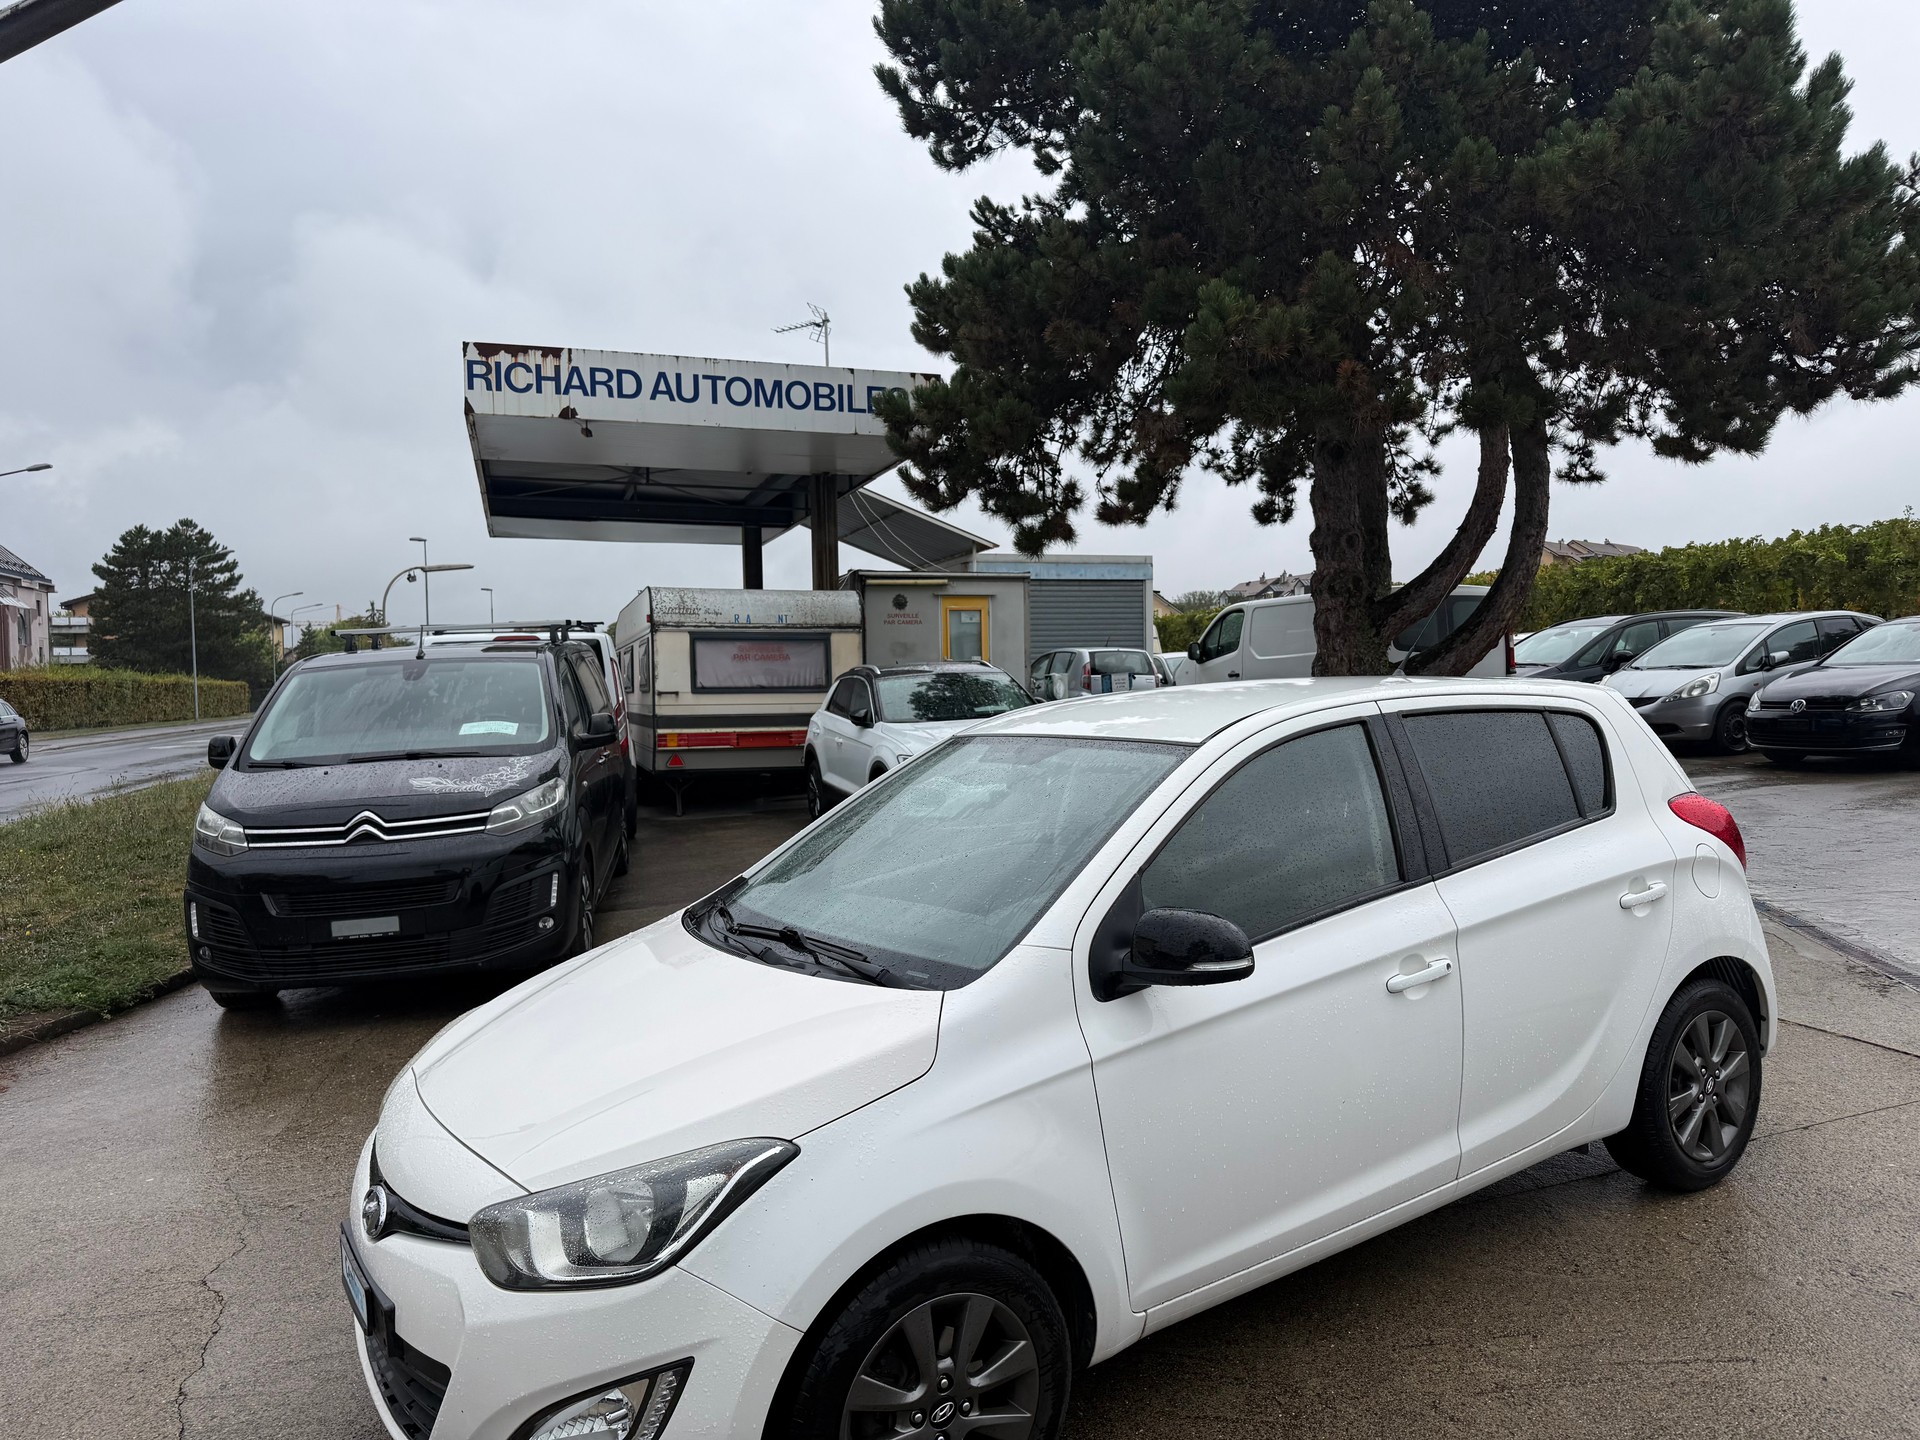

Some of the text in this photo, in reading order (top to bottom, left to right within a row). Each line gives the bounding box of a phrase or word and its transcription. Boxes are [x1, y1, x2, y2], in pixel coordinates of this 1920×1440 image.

[467, 359, 909, 416] RICHARD AUTOMOBILE
[733, 653, 751, 661] PAR
